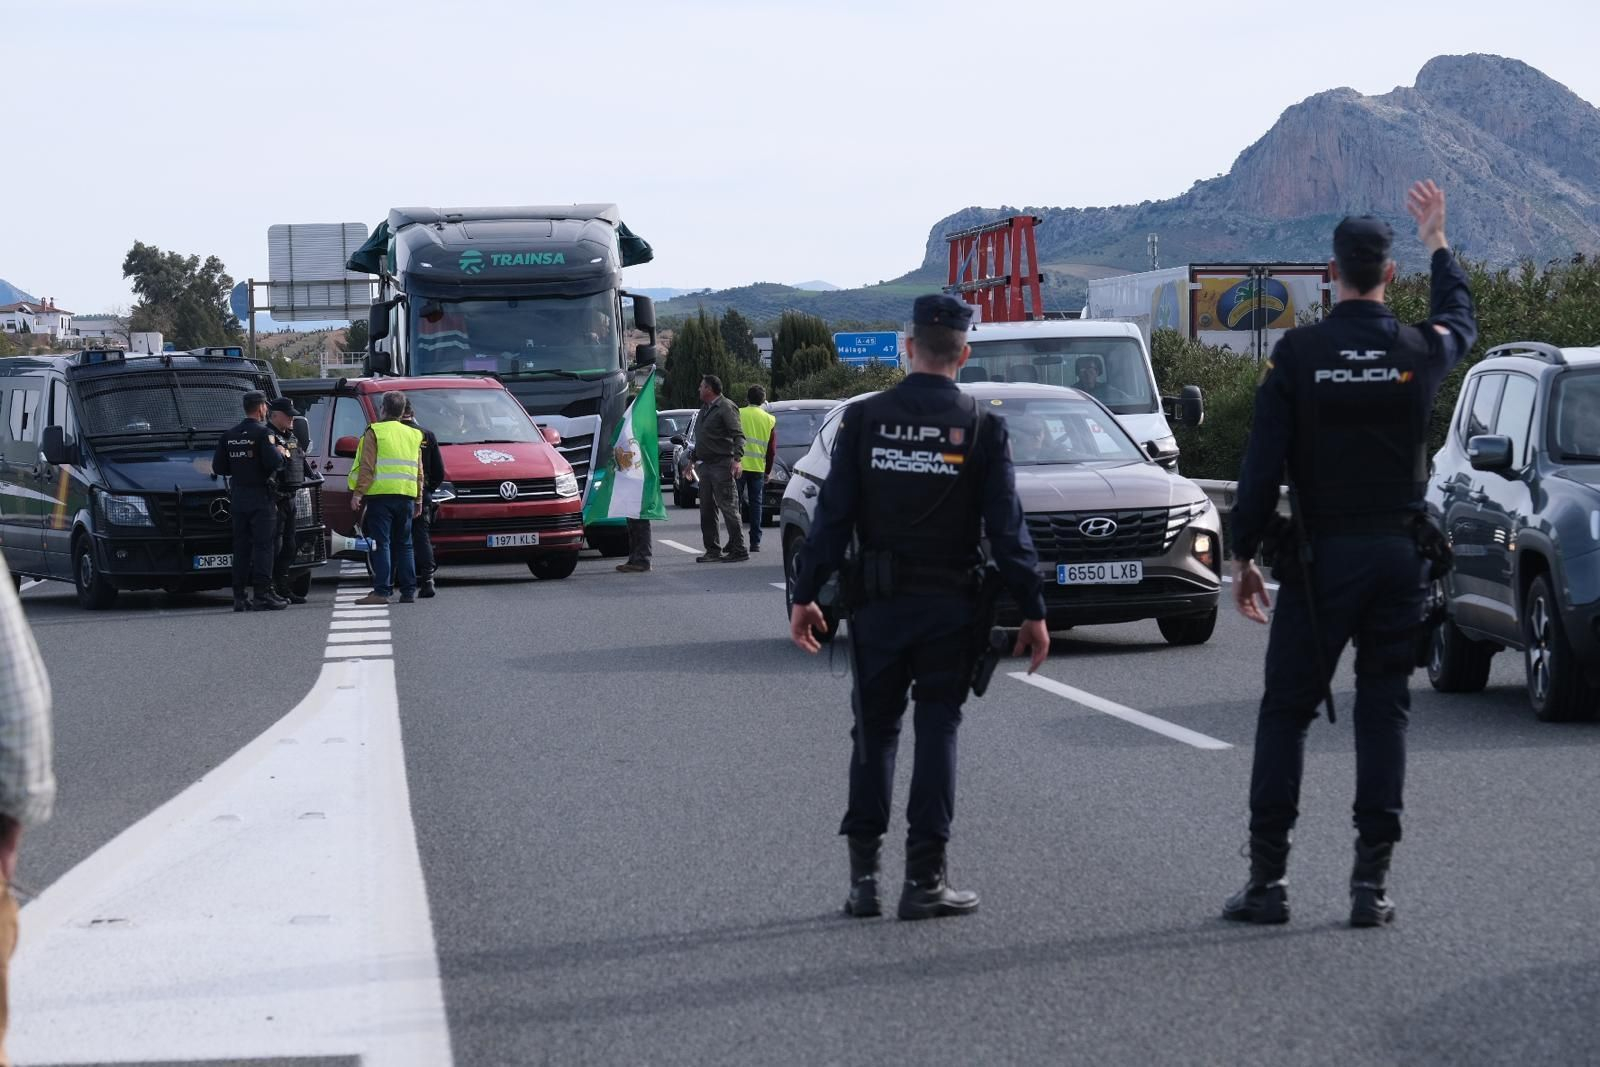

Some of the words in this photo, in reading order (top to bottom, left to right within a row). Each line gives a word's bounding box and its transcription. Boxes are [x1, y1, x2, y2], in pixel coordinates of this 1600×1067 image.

[491, 252, 565, 266] TRAINSA
[838, 345, 867, 354] Málaga
[1315, 368, 1400, 383] POLICIA
[880, 424, 946, 443] U.I.P.
[872, 447, 944, 463] POLICIA
[871, 459, 959, 475] NACIONAL
[496, 535, 516, 546] 1971
[520, 534, 537, 545] KLS
[1068, 565, 1106, 581] 6550
[1111, 563, 1138, 580] LXB
